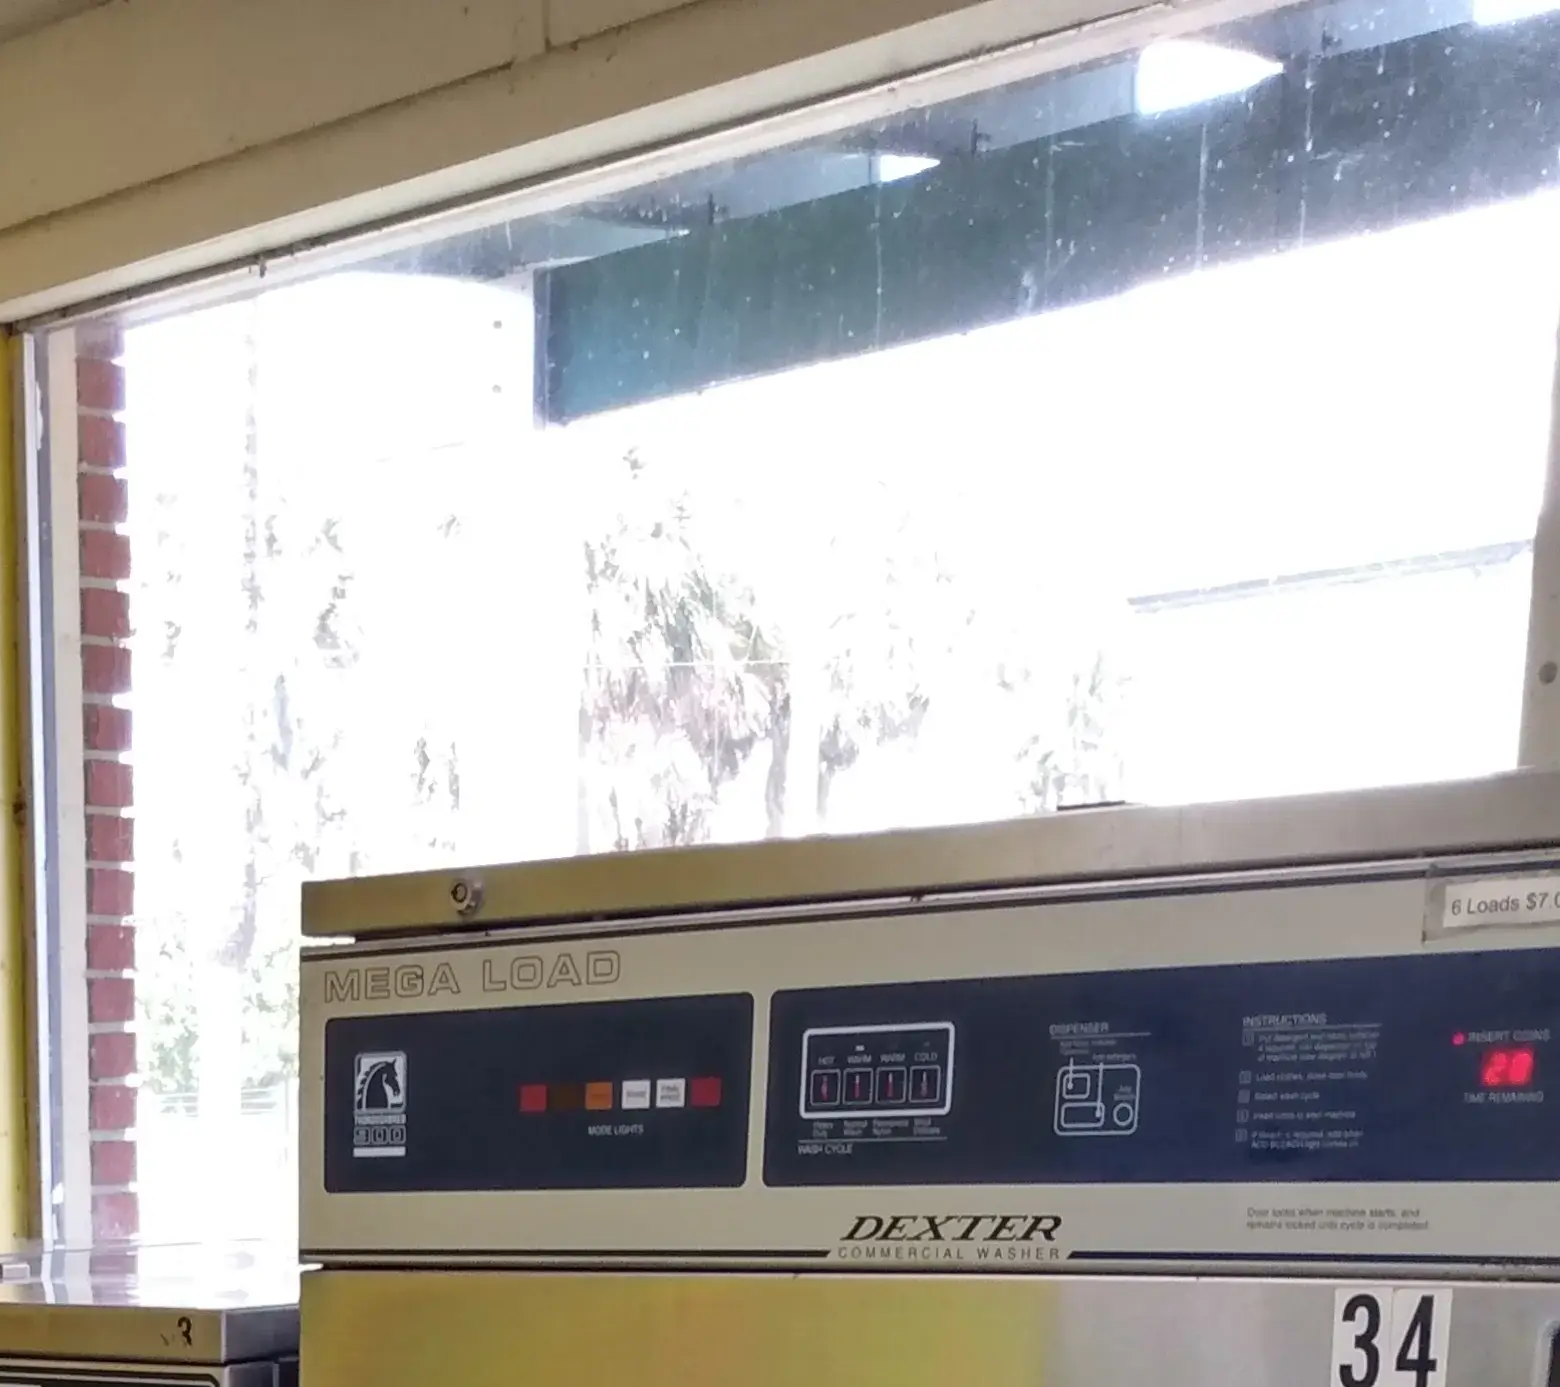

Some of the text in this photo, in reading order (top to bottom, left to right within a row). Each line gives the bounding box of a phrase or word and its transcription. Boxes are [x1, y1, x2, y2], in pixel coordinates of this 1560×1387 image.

[1451, 899, 1462, 916] 6
[1467, 895, 1520, 915] Loads
[324, 950, 622, 1003] MEGA LOAD
[1242, 1013, 1327, 1027] INSTRUCTIONS
[588, 1124, 644, 1136] MODE LIGHTS
[839, 1215, 1062, 1241] DEXTER
[838, 1247, 1060, 1260] COMMERCIAL WASHER
